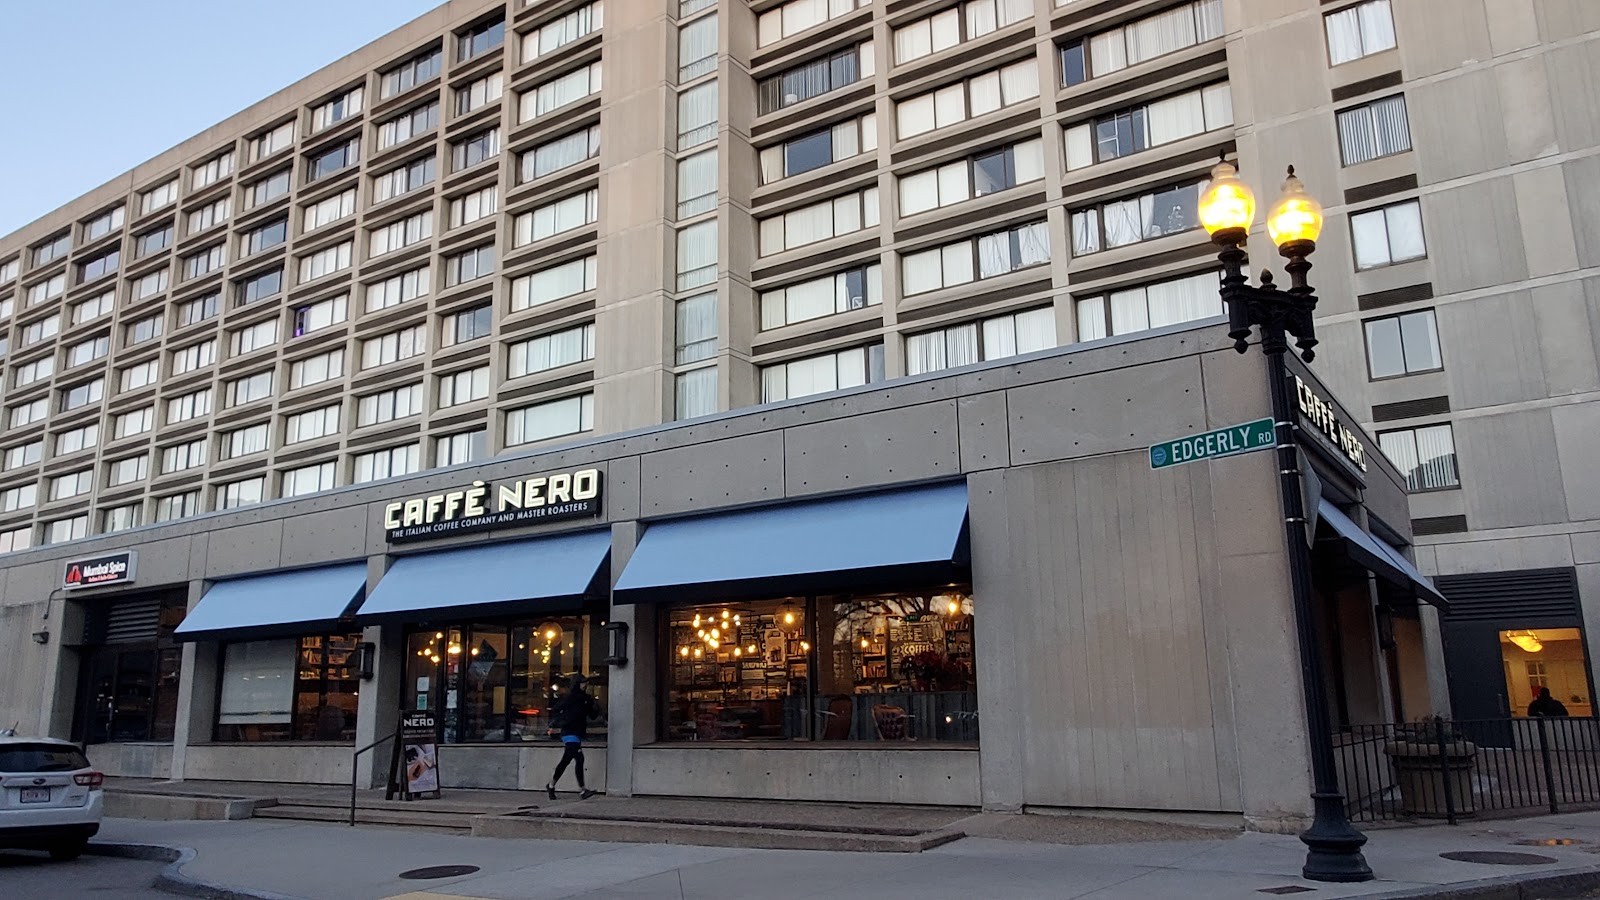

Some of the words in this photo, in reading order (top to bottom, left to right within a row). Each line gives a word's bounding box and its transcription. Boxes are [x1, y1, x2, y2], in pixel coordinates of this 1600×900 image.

[1295, 375, 1338, 444] CAFFÈ
[1338, 423, 1367, 473] NERO
[1171, 426, 1251, 462] EDGERLY
[1258, 431, 1272, 444] RD
[384, 480, 485, 530] CAFFÈ
[498, 468, 599, 512] NERO
[392, 529, 404, 538] THE
[405, 526, 432, 537] ITALIAN
[433, 520, 459, 532] COFFEE
[461, 515, 497, 528] COMPANY
[498, 512, 515, 523] AND
[517, 508, 546, 520] MASTER
[547, 502, 588, 516] ROASTERS
[83, 563, 109, 577] Mumbai
[109, 561, 126, 574] Spice
[403, 718, 434, 726] NERO
